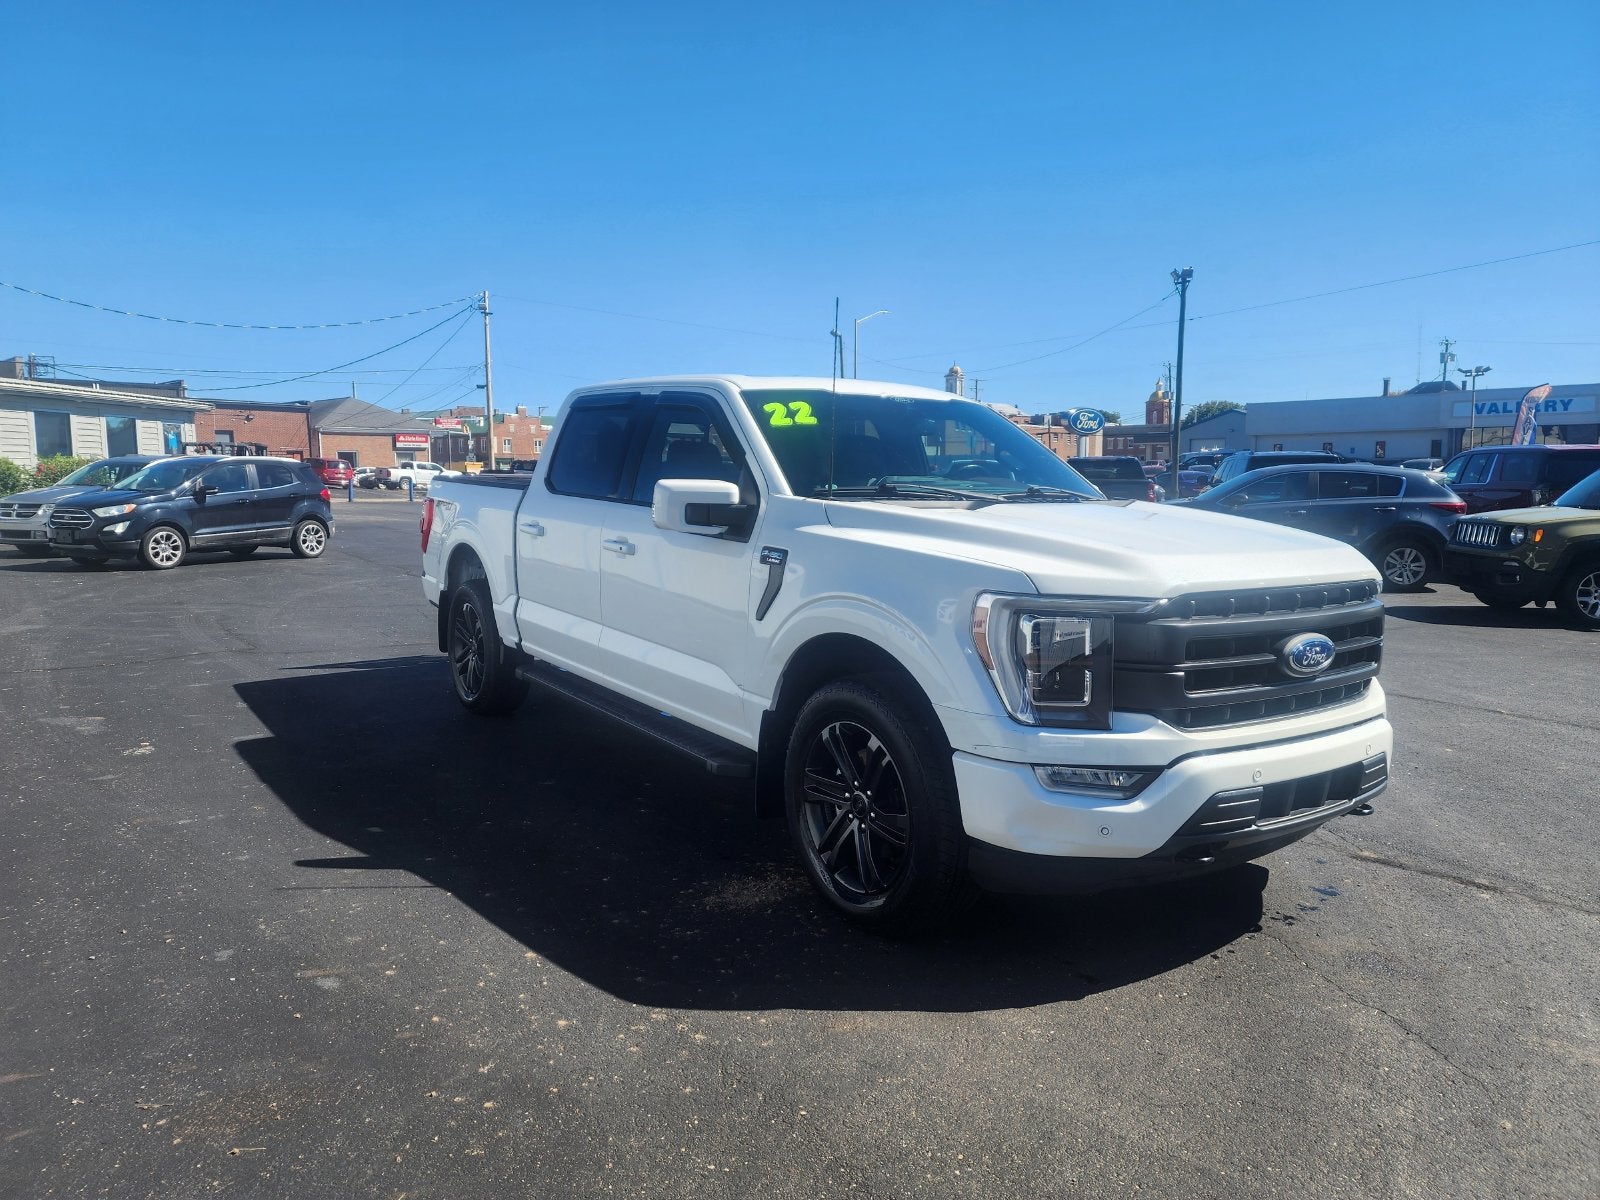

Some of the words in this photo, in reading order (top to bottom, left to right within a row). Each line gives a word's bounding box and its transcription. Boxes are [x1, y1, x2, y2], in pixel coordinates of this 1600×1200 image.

[763, 401, 818, 426] 22
[1077, 412, 1100, 429] Ford
[1302, 646, 1327, 665] Ford
